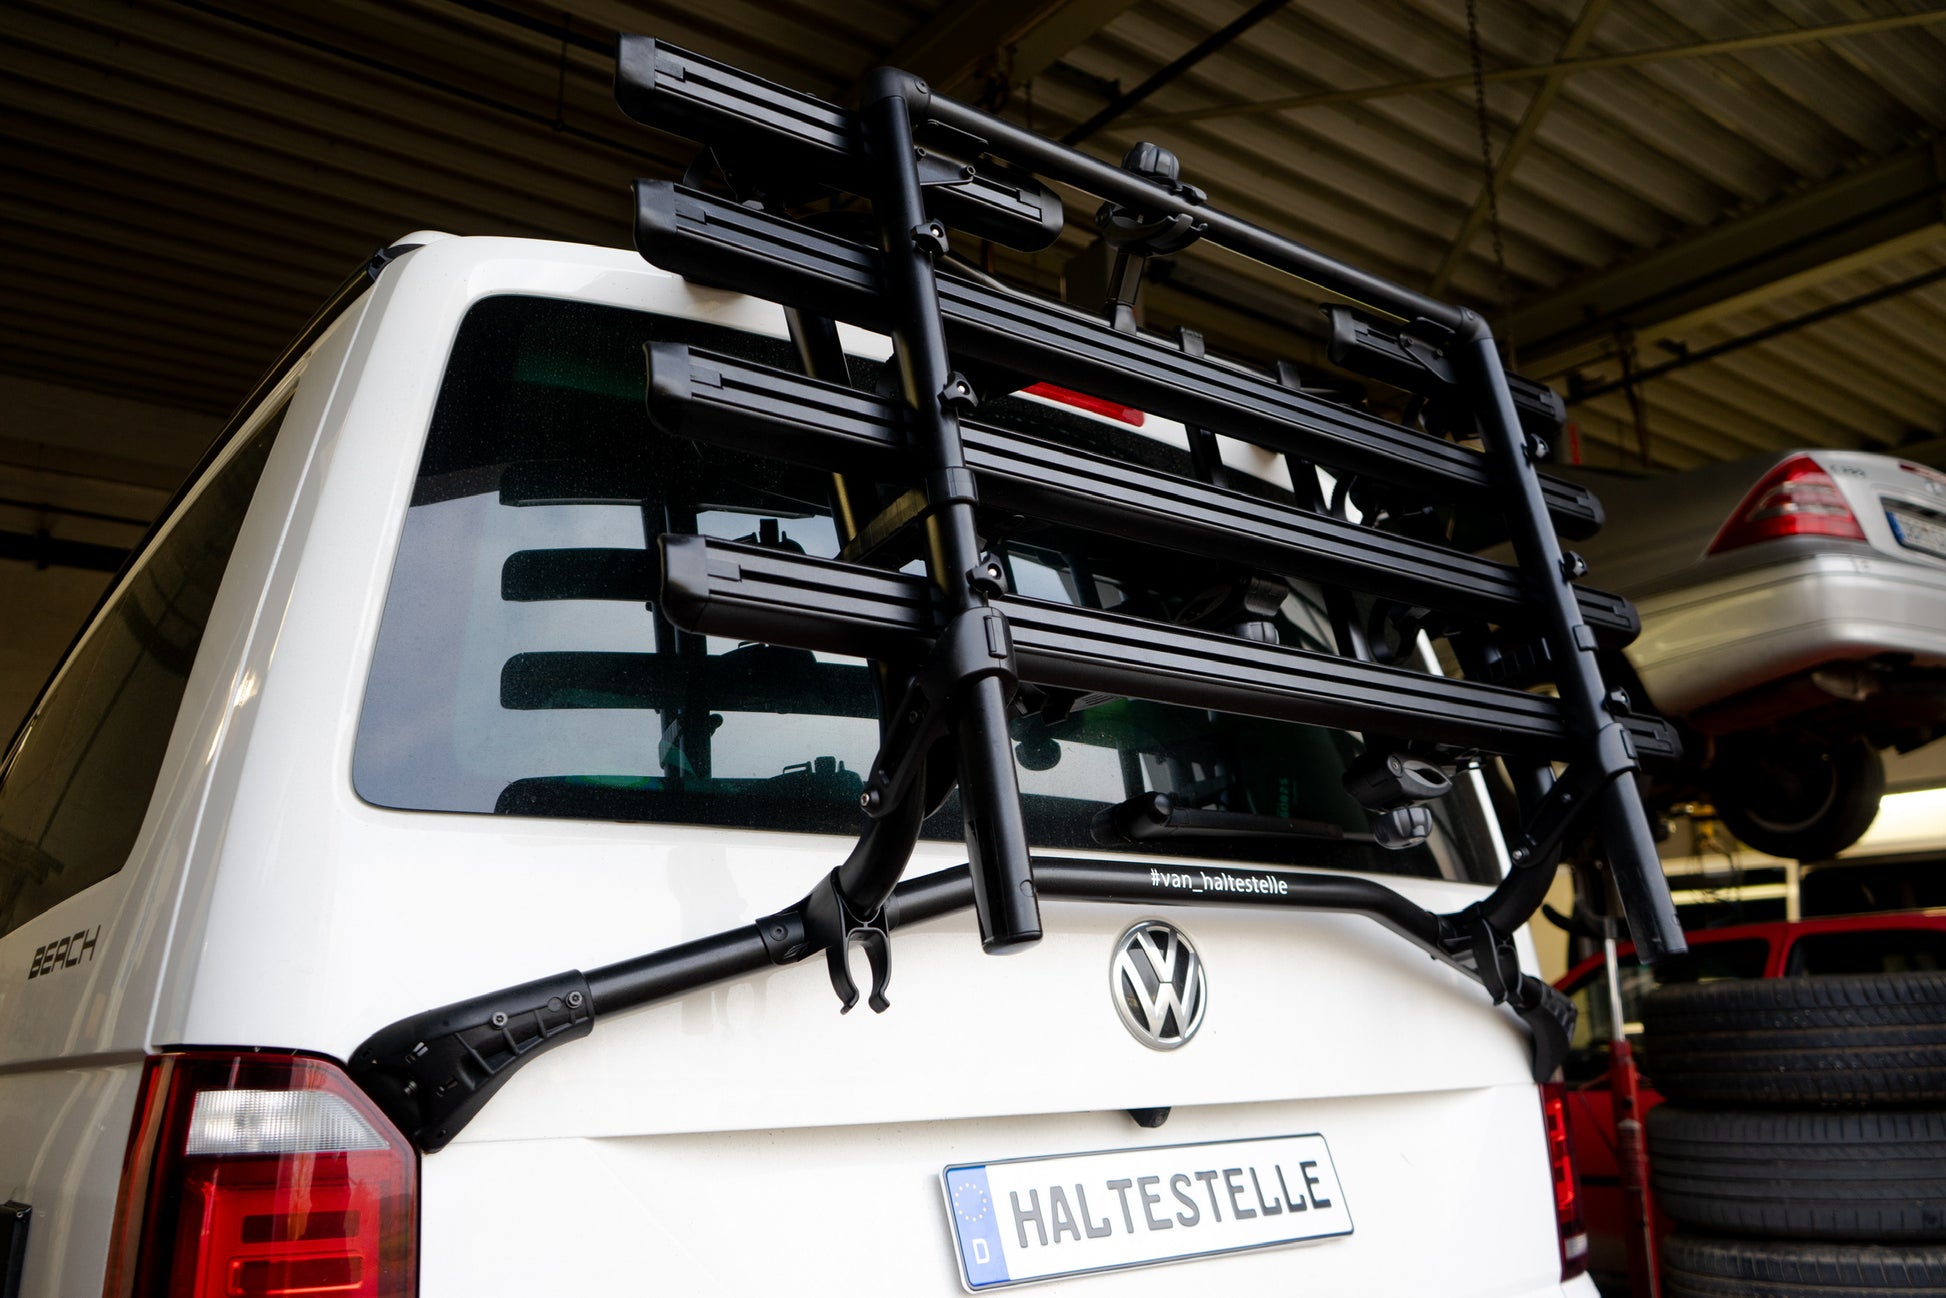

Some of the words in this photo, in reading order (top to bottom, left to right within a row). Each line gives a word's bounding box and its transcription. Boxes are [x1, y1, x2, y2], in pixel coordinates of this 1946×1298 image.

[1150, 868, 1288, 895] #van_haltestelle
[28, 924, 101, 980] BEACH
[1009, 1160, 1332, 1248] HALTESTELLE
[972, 1238, 990, 1265] D
